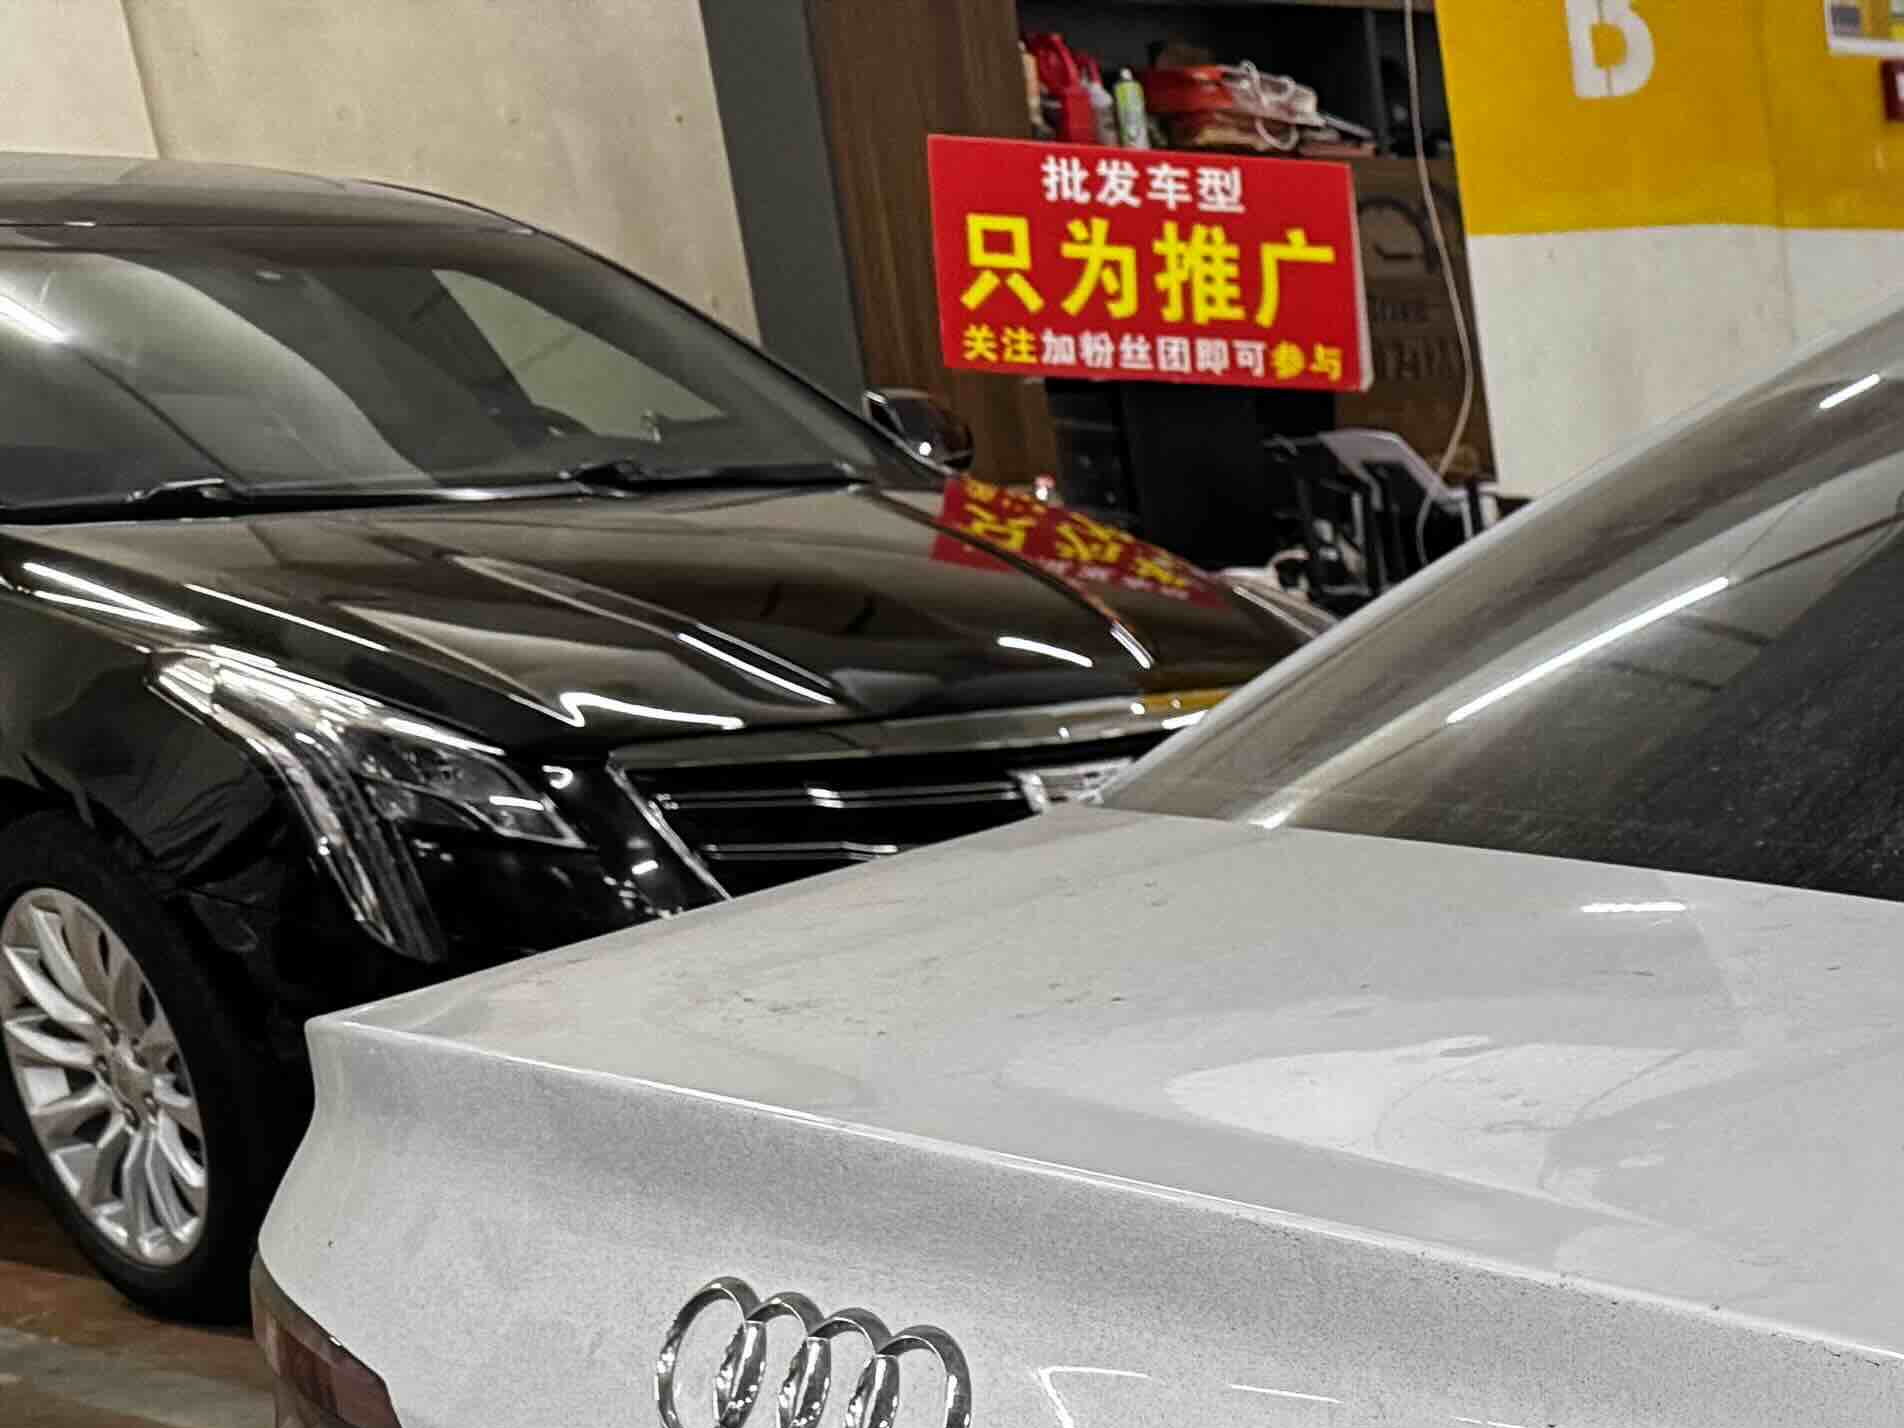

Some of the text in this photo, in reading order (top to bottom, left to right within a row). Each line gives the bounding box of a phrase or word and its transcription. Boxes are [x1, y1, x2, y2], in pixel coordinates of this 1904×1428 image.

[1040, 154, 1247, 214] 批发车型
[960, 212, 1336, 328] 只为推广
[962, 325, 1343, 382] 关注加粉丝团即可参与
